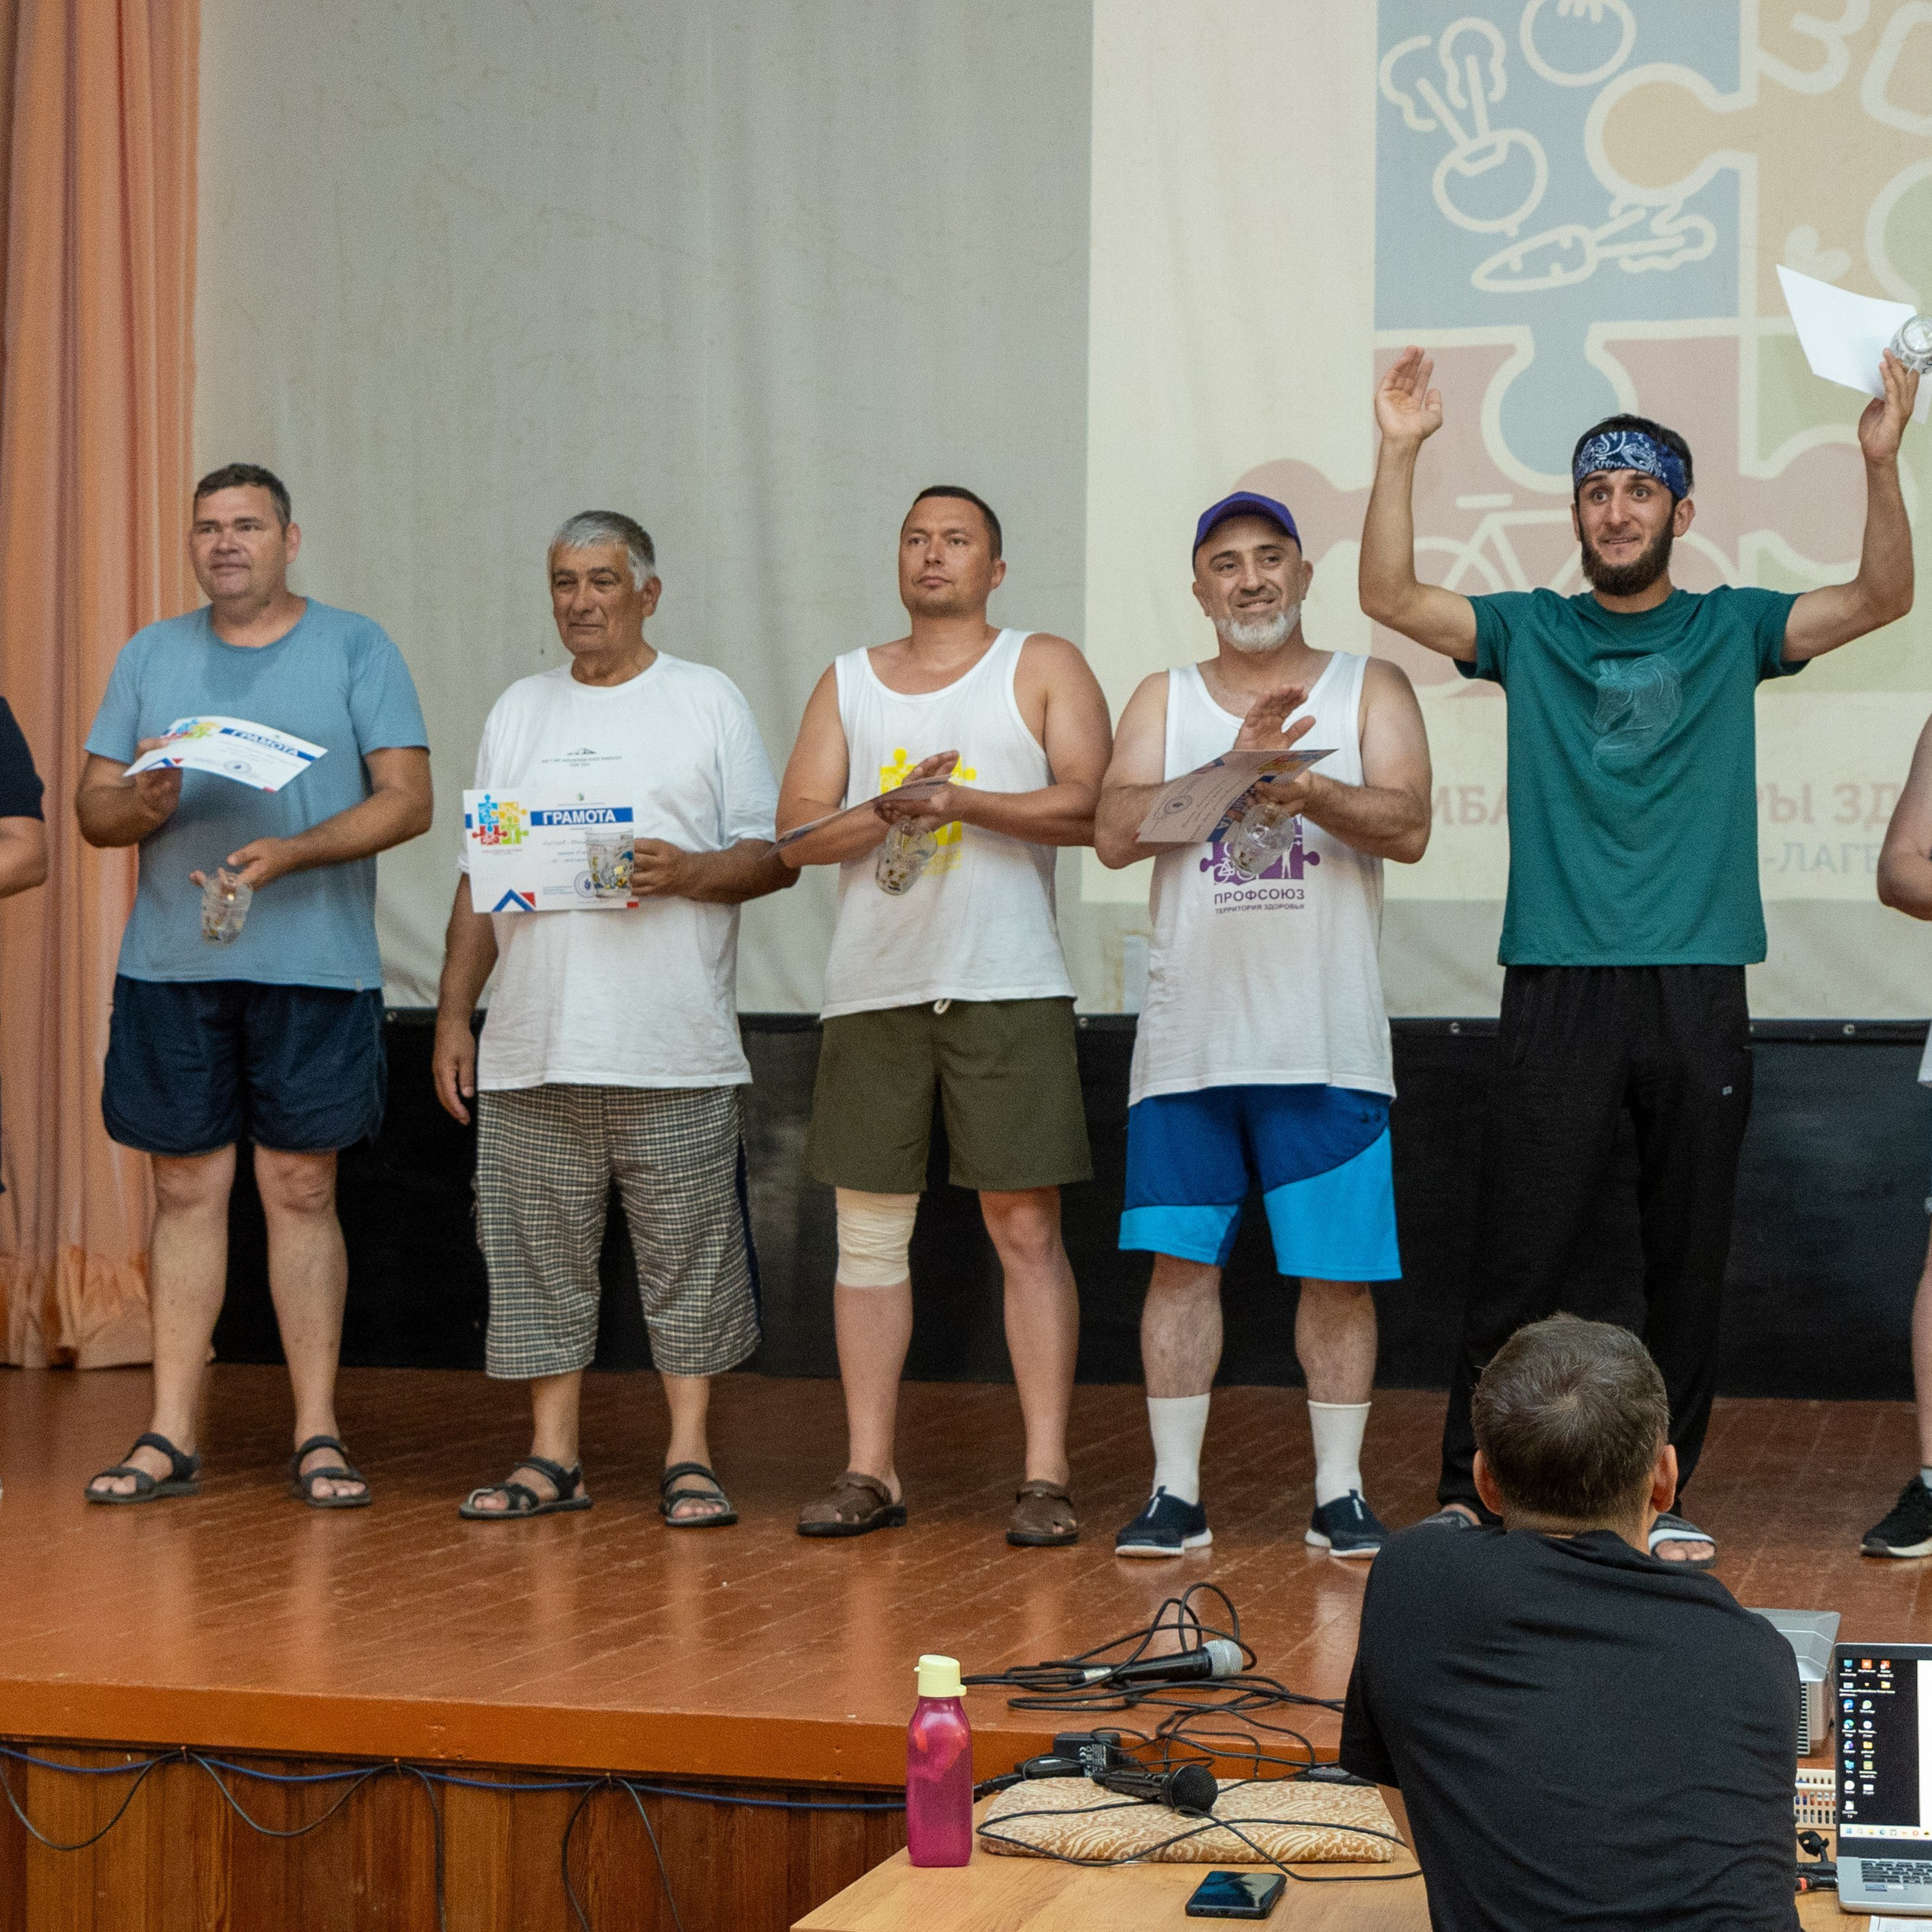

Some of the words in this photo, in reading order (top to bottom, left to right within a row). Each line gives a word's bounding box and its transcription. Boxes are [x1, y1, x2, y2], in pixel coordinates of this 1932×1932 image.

[543, 809, 617, 825] ГРАМОТА
[1214, 888, 1305, 905] ПРОФСОЮЗ
[1216, 904, 1263, 915] ТЕРРИТОРИЯ
[1264, 903, 1305, 911] ЗДОРОВЬЯ
